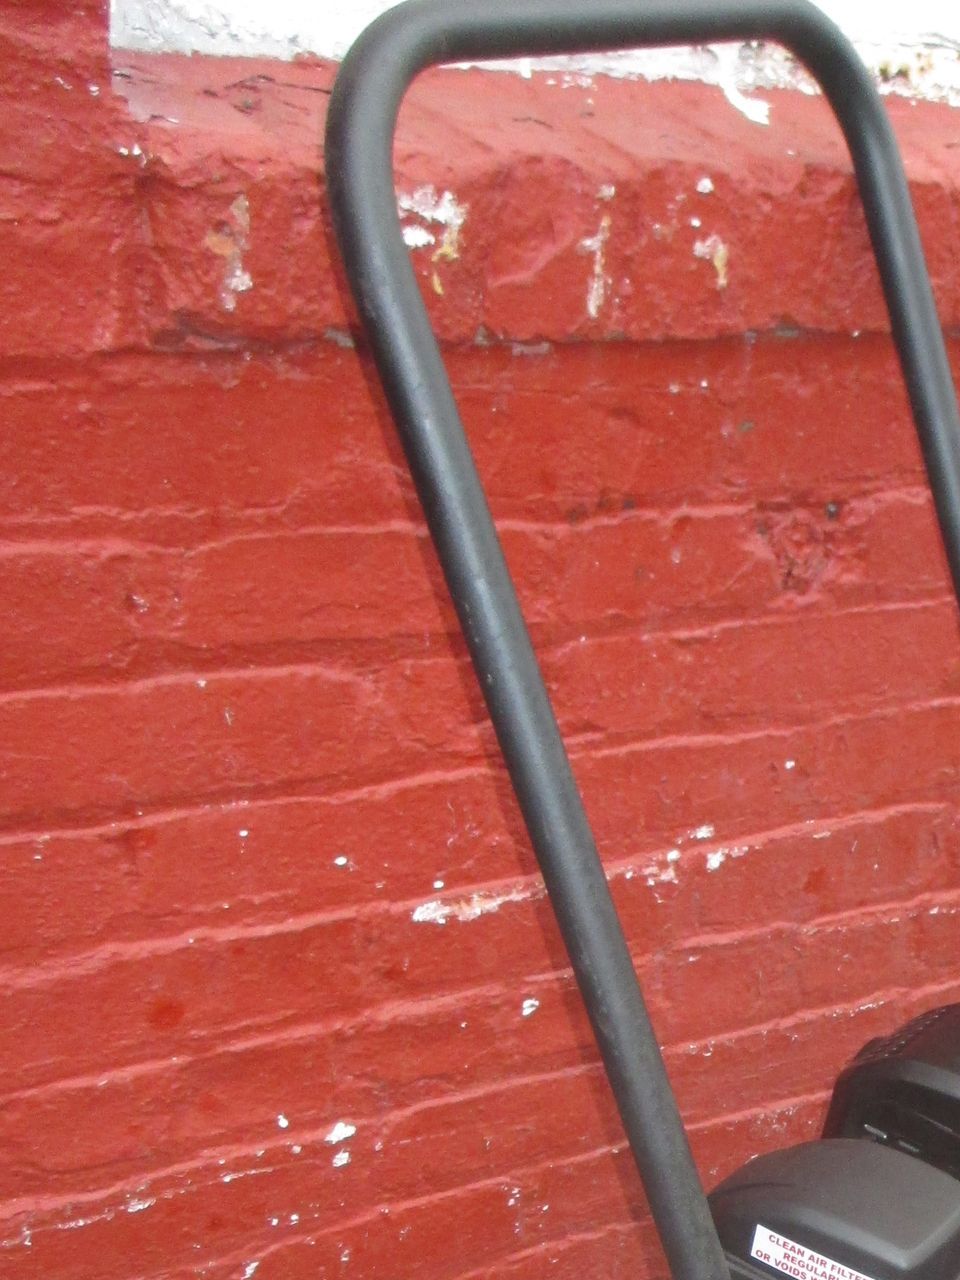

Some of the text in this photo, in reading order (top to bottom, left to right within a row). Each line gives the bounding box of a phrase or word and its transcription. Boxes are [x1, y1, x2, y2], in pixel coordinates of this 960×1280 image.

[754, 1249, 771, 1261] OR
[772, 1258, 808, 1280] VOIDS
[767, 1233, 806, 1257] CLEAN
[807, 1253, 827, 1267] AIR
